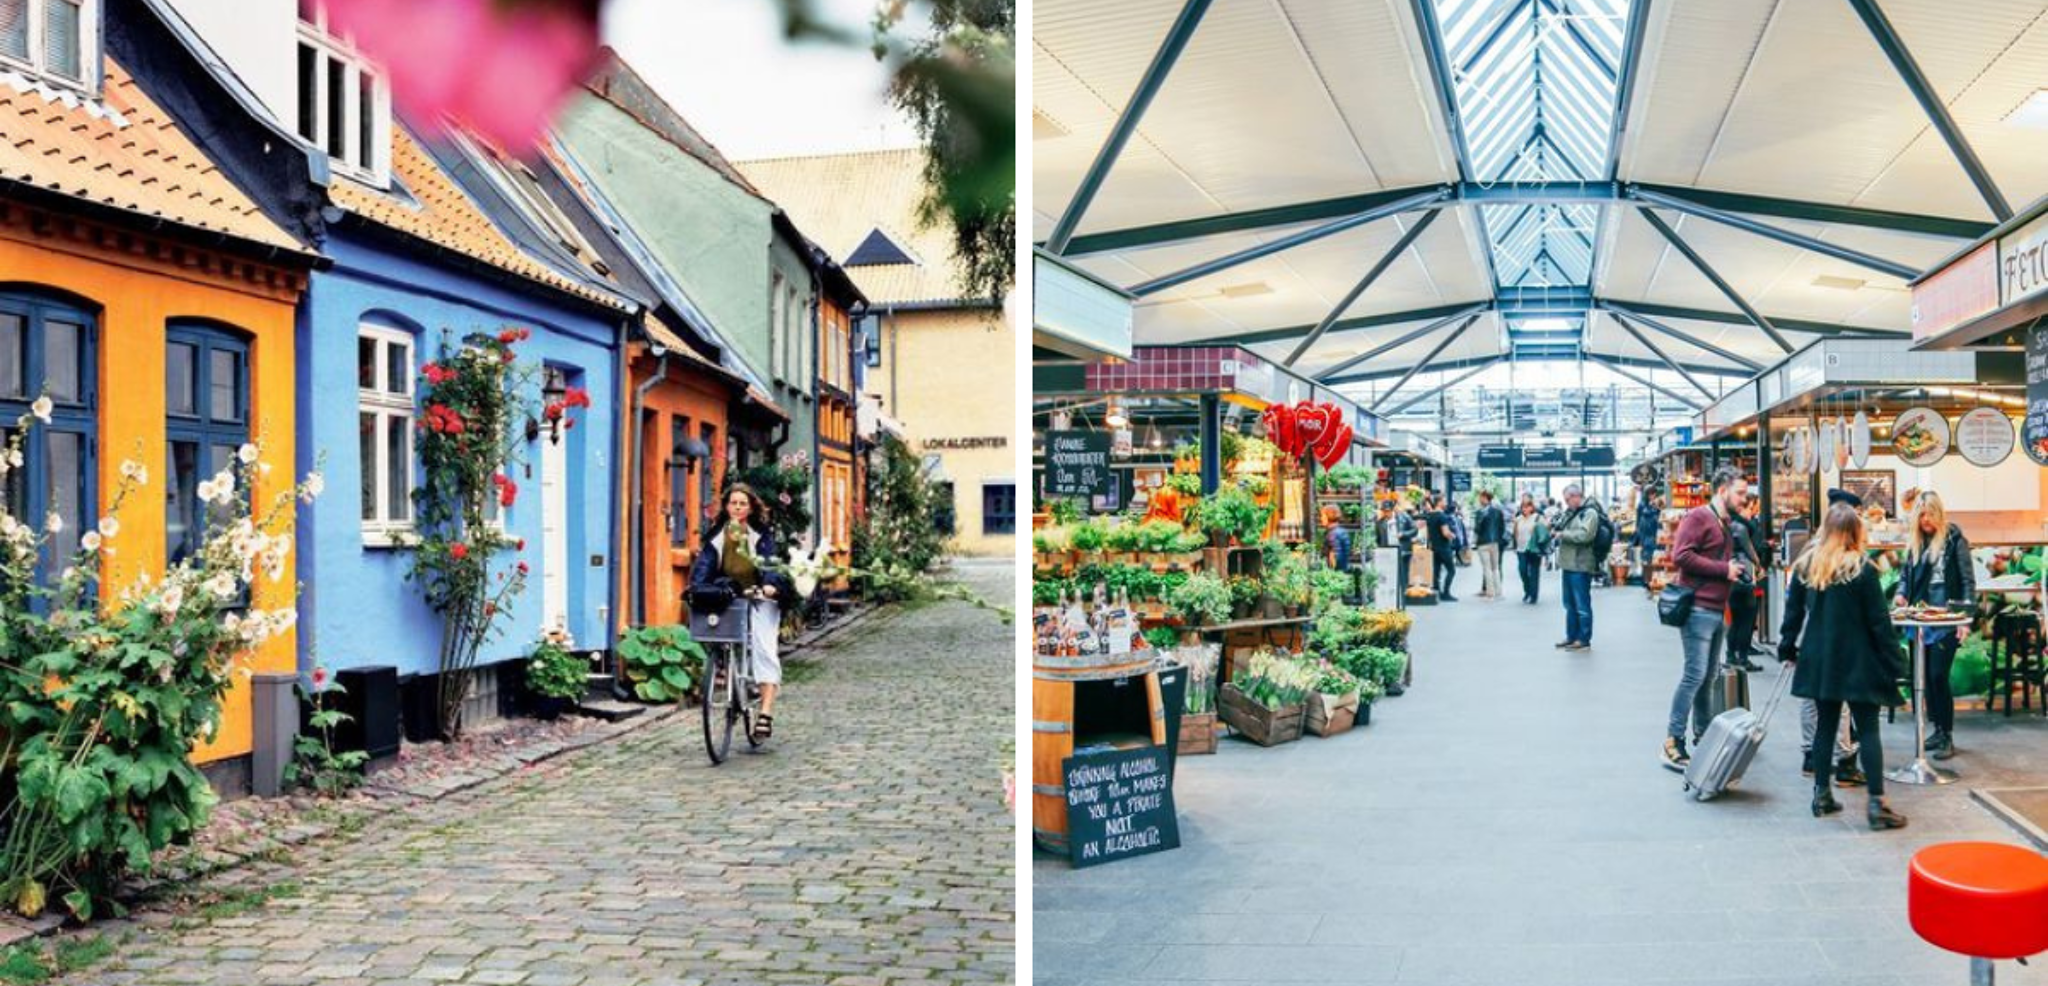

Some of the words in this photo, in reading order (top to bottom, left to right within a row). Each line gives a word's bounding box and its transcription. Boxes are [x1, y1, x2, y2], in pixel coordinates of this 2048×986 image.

[923, 436, 1007, 449] LOKALCENTER
[1120, 758, 1159, 778] ALCOHOL
[1133, 774, 1167, 793] MAKES
[1088, 803, 1107, 820] YOU
[1112, 801, 1123, 815] A
[1127, 793, 1162, 813] PIRATE
[1105, 814, 1135, 837] NOT
[1082, 841, 1100, 859] AN
